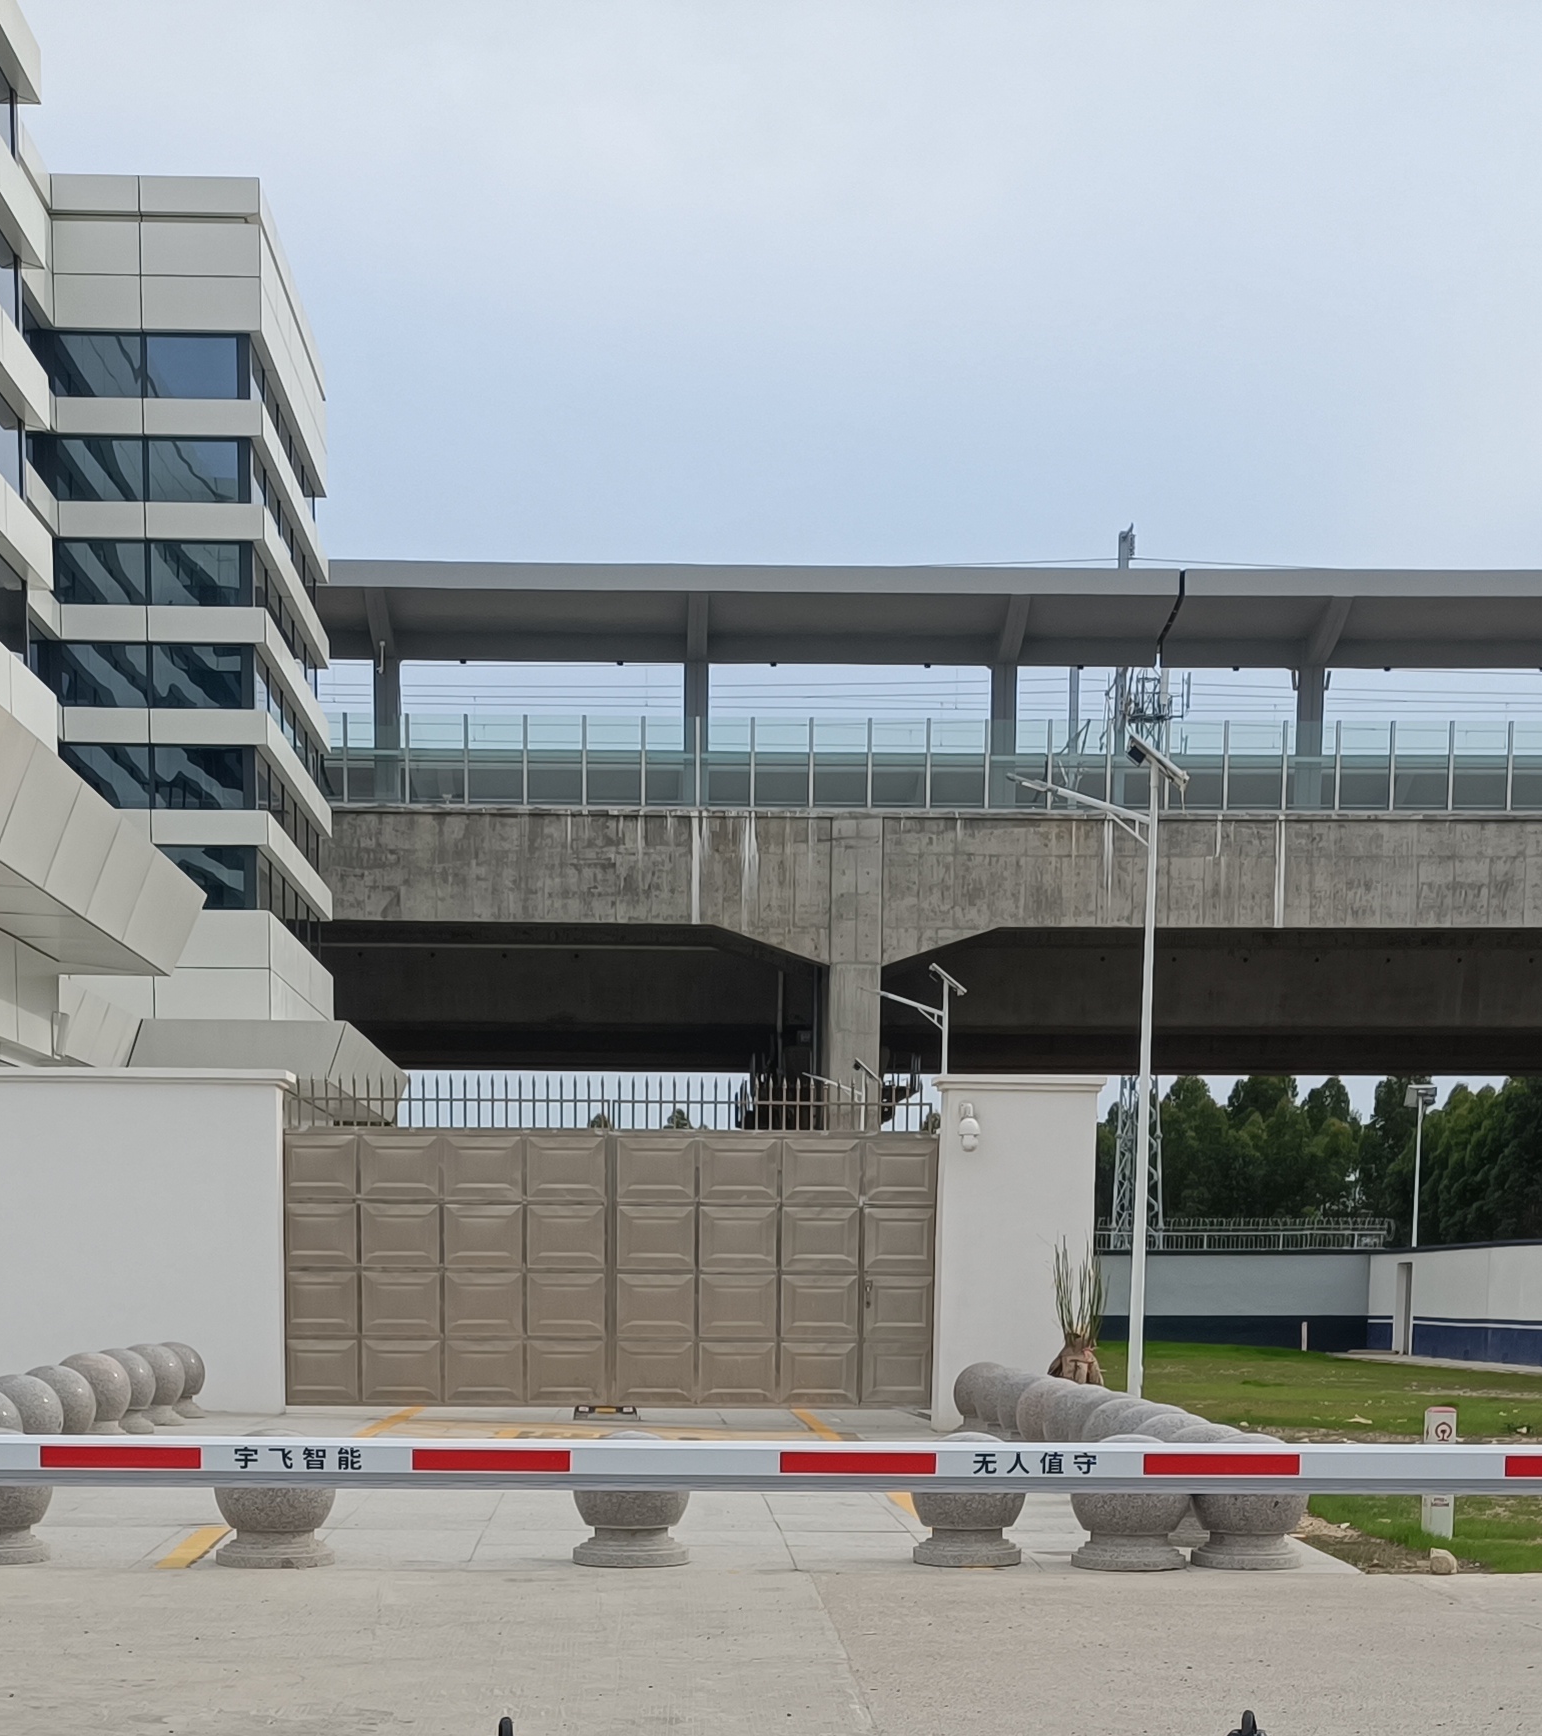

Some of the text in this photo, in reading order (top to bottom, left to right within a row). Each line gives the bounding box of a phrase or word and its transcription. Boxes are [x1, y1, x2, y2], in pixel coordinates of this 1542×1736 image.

[234, 1447, 362, 1470] 宇飞智能
[973, 1452, 1097, 1475] 无人值守
